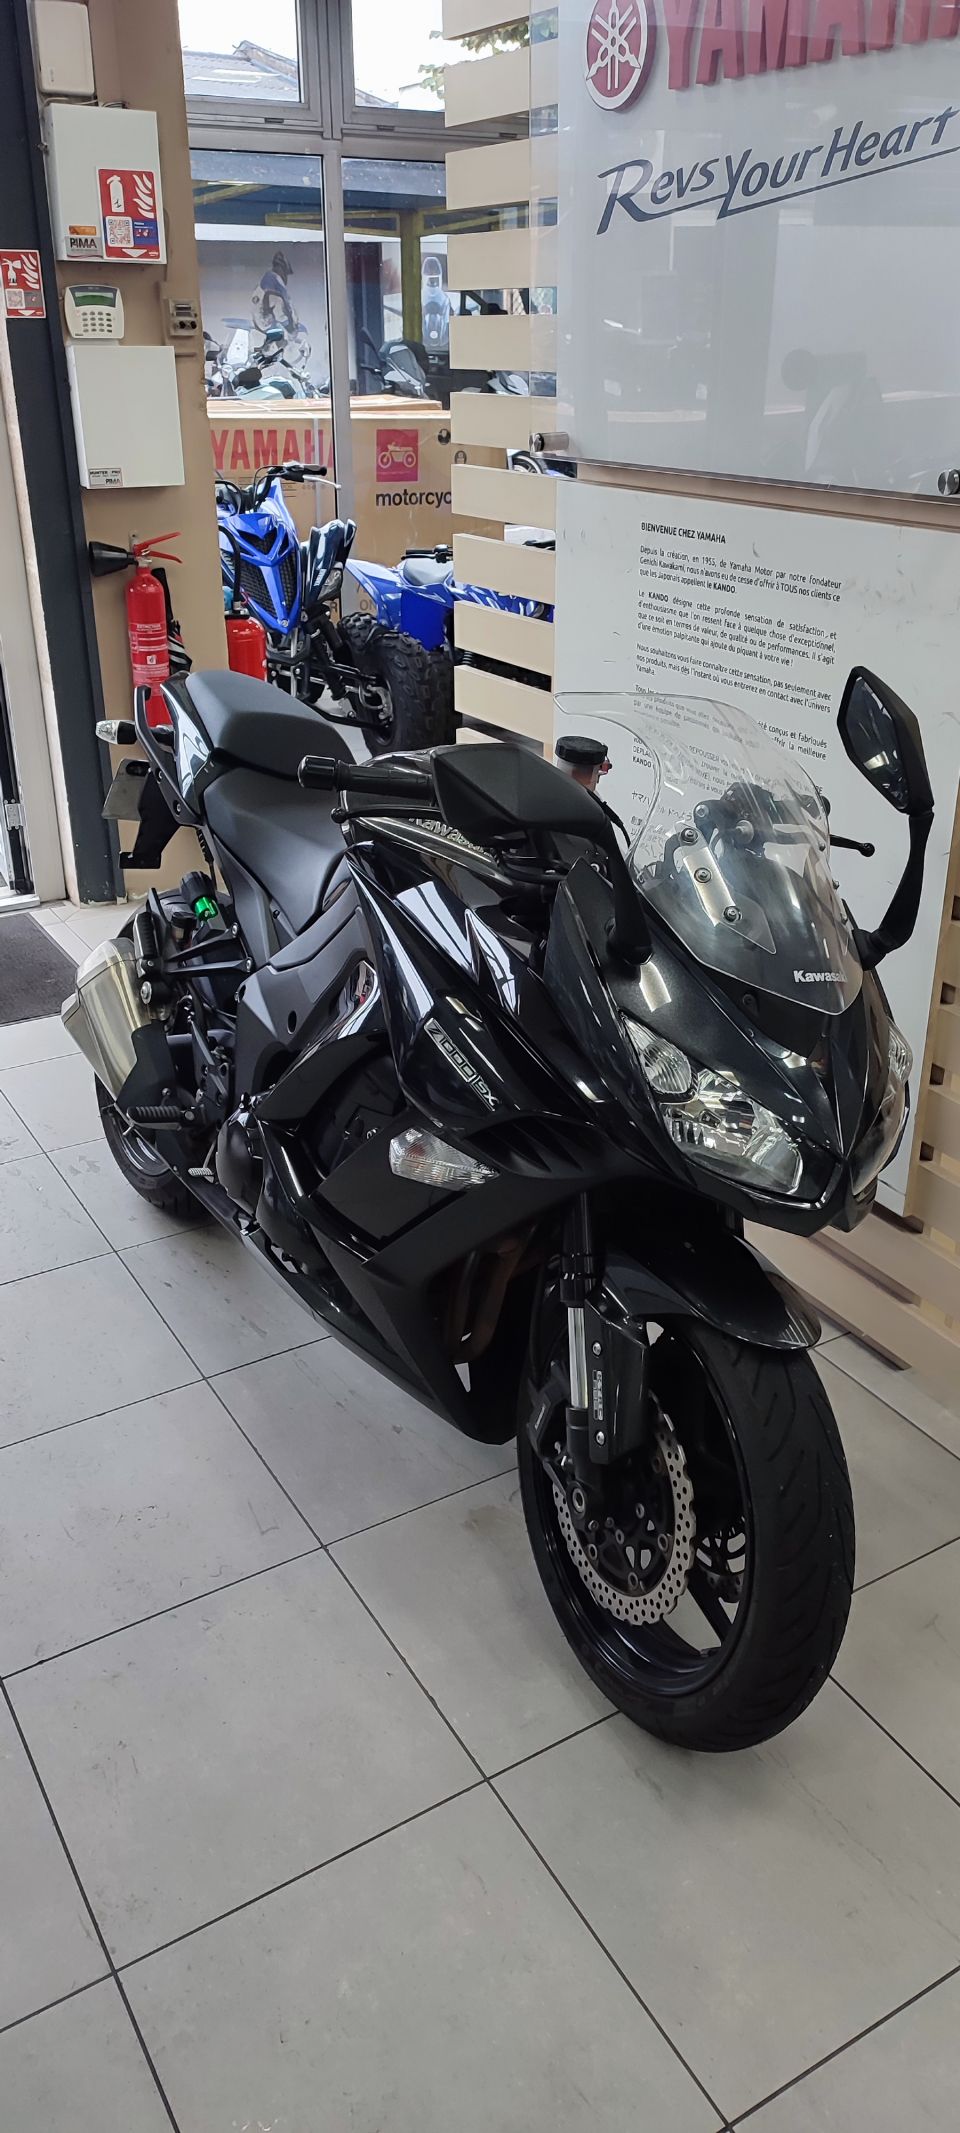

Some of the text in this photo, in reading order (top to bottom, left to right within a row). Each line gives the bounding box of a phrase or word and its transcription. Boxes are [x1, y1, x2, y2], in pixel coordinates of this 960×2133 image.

[663, 0, 959, 89] YAMA
[597, 106, 959, 234] Revs Your Heart
[70, 237, 97, 248] PIMA
[641, 522, 726, 544] BIENVENUE CHEZ YAMAHA
[640, 545, 658, 555] Depuis
[660, 548, 664, 557] la
[719, 559, 727, 568] de
[730, 561, 751, 572] Yamaha
[754, 566, 773, 576] Motor
[775, 571, 786, 579] par
[789, 572, 806, 582] notre
[809, 574, 842, 589] fondateur
[640, 569, 649, 577] que
[681, 577, 706, 588] appellent
[707, 579, 712, 589] le
[687, 567, 700, 575] nous
[700, 568, 720, 579] n'avons
[729, 573, 736, 582] de
[738, 575, 753, 585] cesse
[754, 578, 775, 589] d'offrir
[781, 582, 798, 594] TOUS
[799, 588, 810, 596] nos
[810, 588, 832, 600] clients
[832, 594, 840, 602] ce
[638, 600, 677, 616] d'enthousiasme
[678, 610, 689, 619] que
[690, 611, 700, 620] l'on
[702, 616, 722, 626] ressent
[724, 619, 736, 629] face
[744, 625, 767, 637] quelque
[769, 629, 786, 640] chose
[788, 634, 836, 653] d'exceptionnel,
[648, 592, 669, 602] KANDO
[673, 596, 692, 608] désigne
[696, 602, 711, 611] cette
[714, 606, 740, 618] profonde
[744, 613, 772, 625] sensation
[777, 619, 784, 628] de
[830, 631, 837, 640] et
[638, 612, 647, 620] que
[655, 615, 664, 623] soit
[674, 620, 692, 630] termes
[693, 624, 700, 632] de
[720, 630, 727, 638] de
[729, 633, 748, 644] qualité
[750, 638, 757, 646] ou
[758, 639, 766, 647] de
[817, 654, 835, 665] s'agit
[638, 622, 651, 631] d'une
[674, 632, 700, 643] palpitante
[700, 638, 709, 646] qui
[710, 640, 727, 651] ajoute
[728, 644, 735, 652] du
[737, 646, 758, 658] piquant
[764, 653, 780, 664] votre
[781, 657, 790, 666] vie
[637, 643, 649, 653] Nous
[677, 655, 689, 663] vous
[690, 656, 702, 666] faire
[702, 661, 728, 673] connaître
[728, 667, 743, 677] cette
[744, 672, 772, 686] sensation,
[774, 680, 783, 688] pas
[784, 682, 816, 697] seulement
[817, 692, 831, 701] avec
[669, 663, 680, 672] mais
[681, 666, 690, 675] dès
[691, 668, 711, 680] l'instant
[713, 674, 719, 682] où
[720, 678, 733, 687] vous
[734, 681, 758, 693] entrerez
[767, 690, 789, 702] contact
[790, 696, 803, 706] avec
[804, 698, 830, 713] l'univers
[768, 725, 789, 737] conçus
[790, 731, 796, 739] et
[798, 732, 827, 748] fabriqués
[789, 741, 794, 750] la
[798, 745, 826, 760] meilleure
